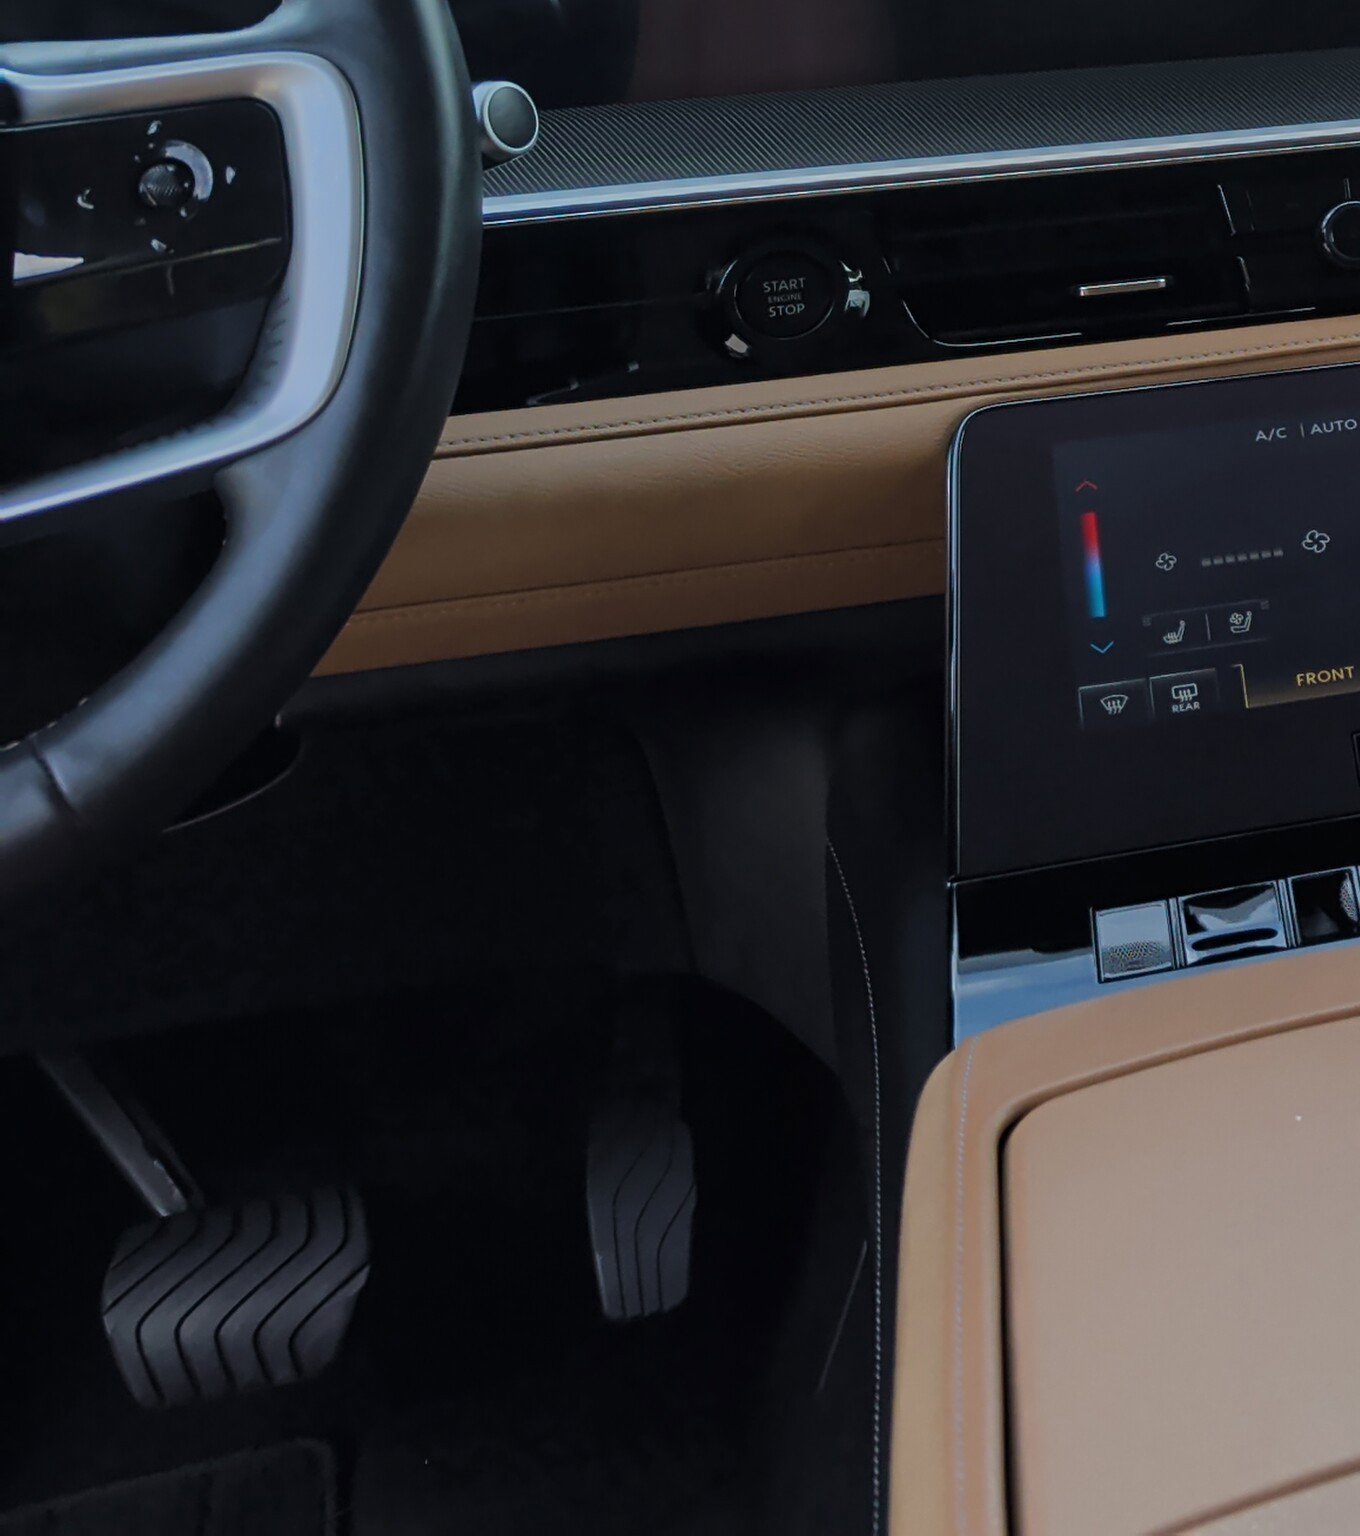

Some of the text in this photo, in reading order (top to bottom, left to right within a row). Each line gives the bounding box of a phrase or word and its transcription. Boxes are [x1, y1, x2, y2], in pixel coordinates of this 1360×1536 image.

[763, 277, 806, 293] START
[769, 303, 805, 318] STOP
[1255, 418, 1357, 443] A/C AUTO
[1296, 665, 1355, 687] FRONT
[1171, 701, 1201, 714] REAR
